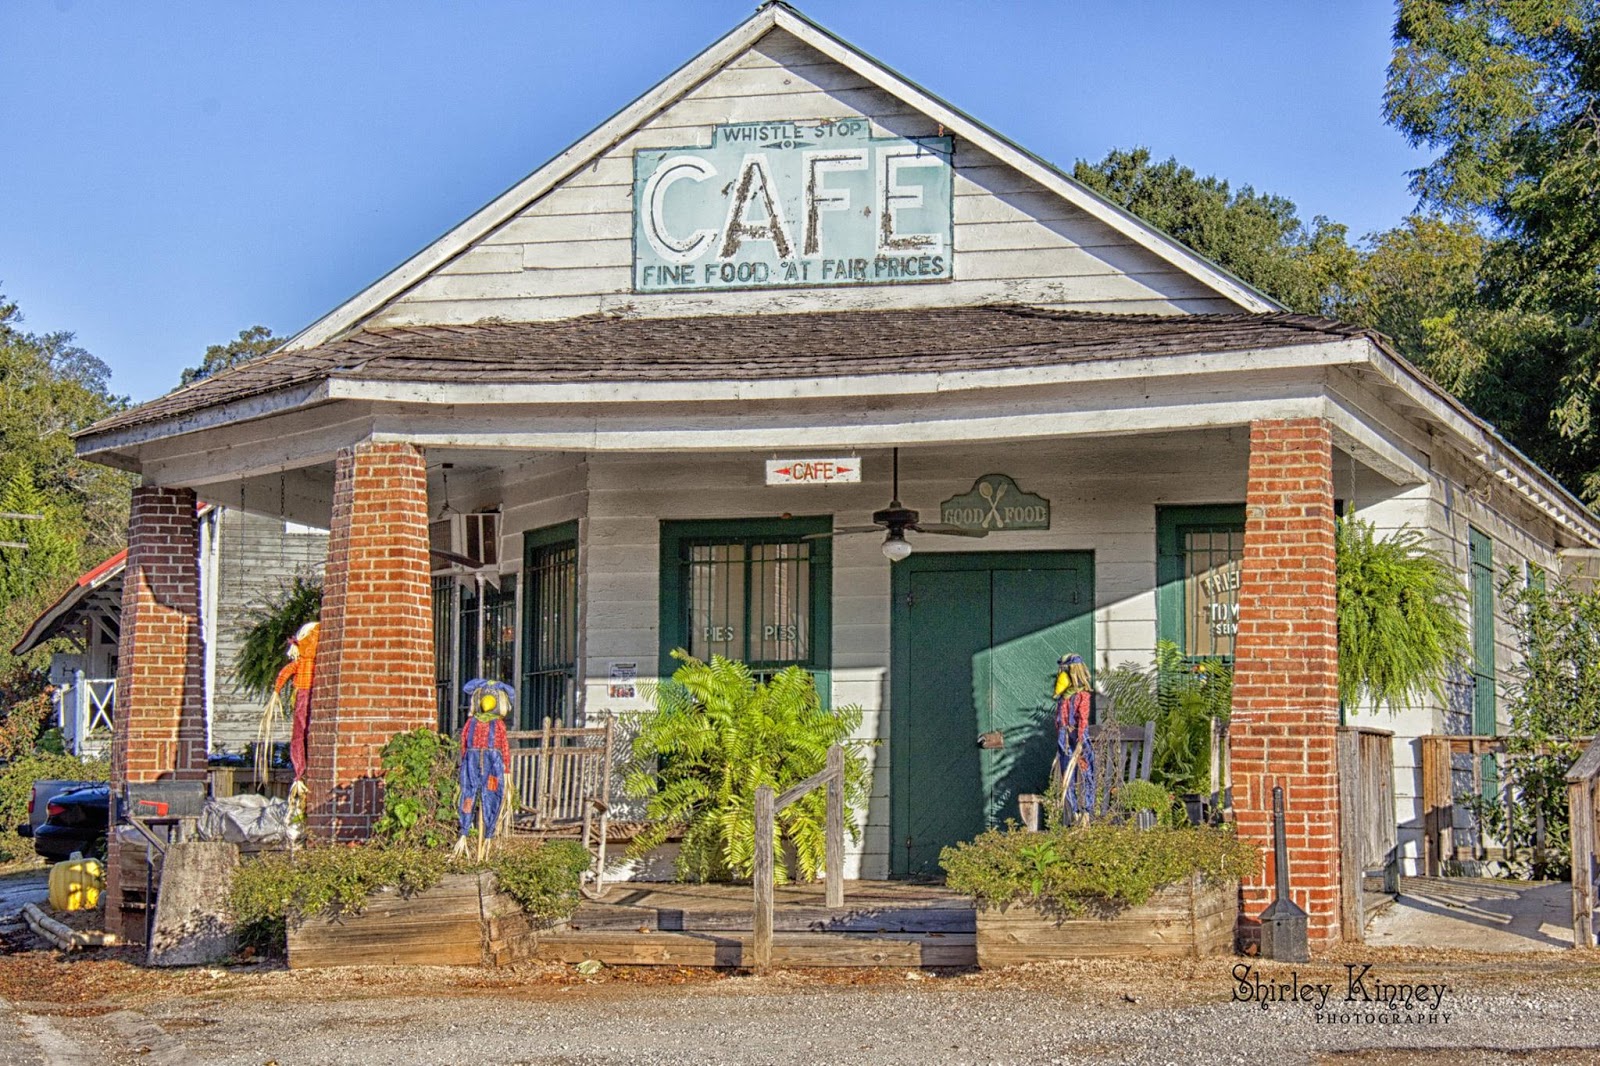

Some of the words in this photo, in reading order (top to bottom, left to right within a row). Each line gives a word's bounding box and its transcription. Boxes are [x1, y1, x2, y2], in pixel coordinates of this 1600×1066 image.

[723, 125, 804, 142] WHISTLE
[814, 120, 862, 138] STOP
[641, 144, 946, 262] CAFE
[643, 264, 696, 286] FINE
[705, 261, 769, 284] FOOD
[783, 262, 811, 281] AT
[822, 258, 869, 281] FAIR
[874, 255, 945, 278] PRICES
[792, 462, 834, 480] CAFE
[944, 508, 984, 525] GOOD
[1004, 505, 1047, 522] FOOD
[703, 626, 734, 642] PIES
[764, 625, 796, 641] PIES
